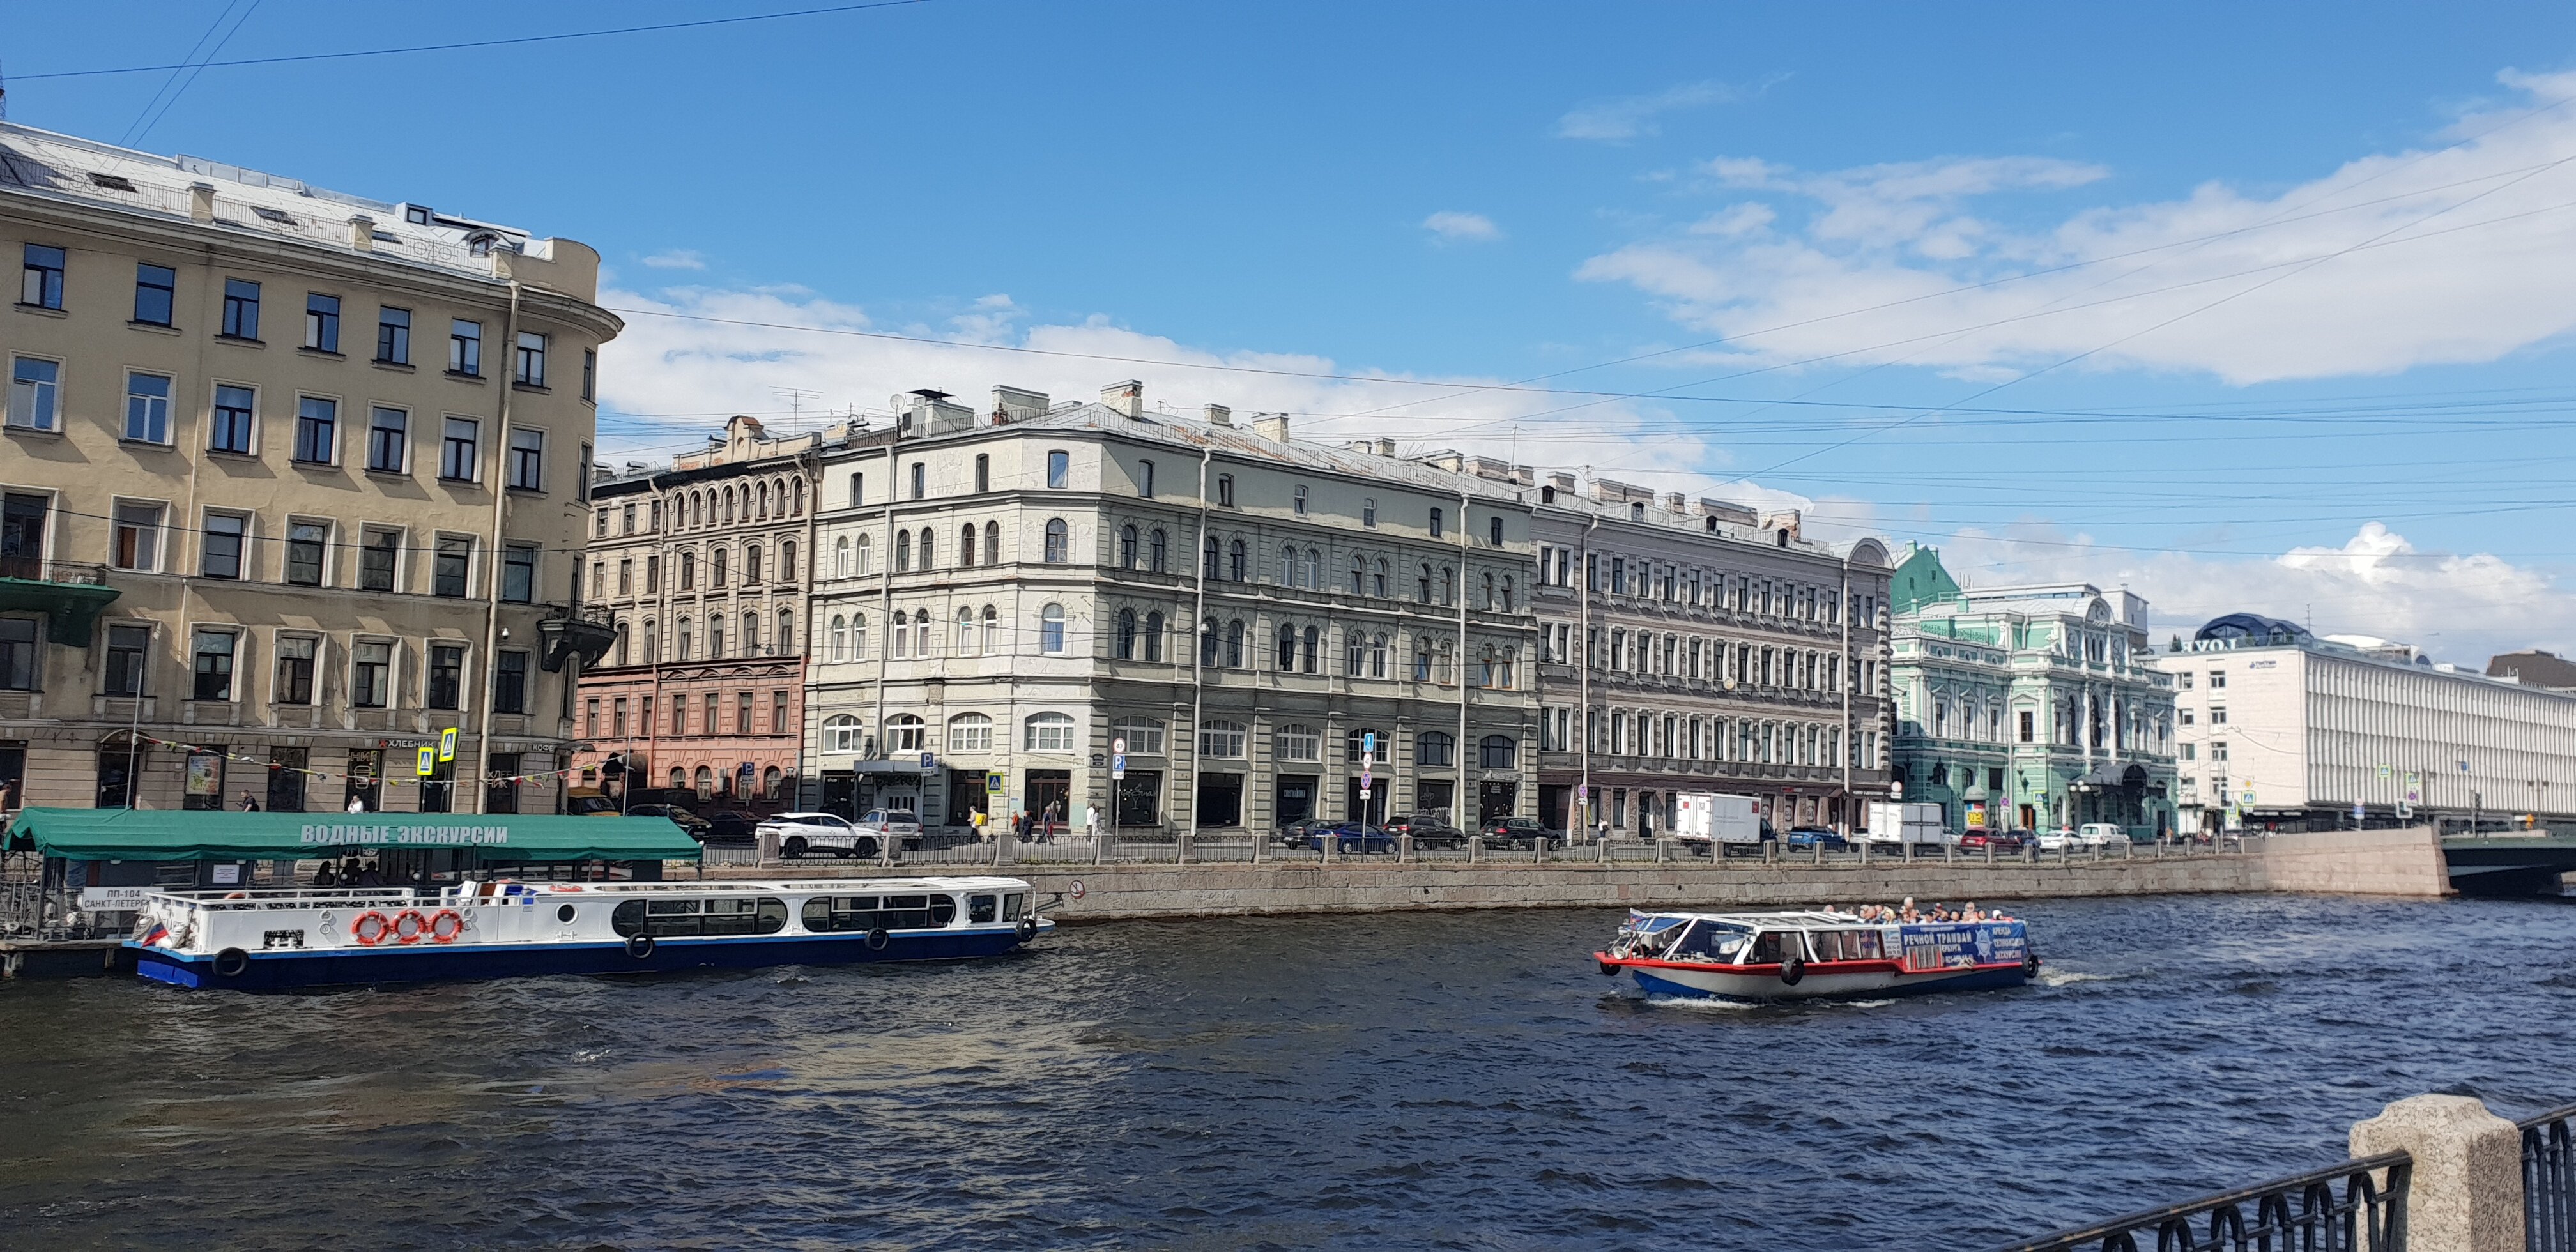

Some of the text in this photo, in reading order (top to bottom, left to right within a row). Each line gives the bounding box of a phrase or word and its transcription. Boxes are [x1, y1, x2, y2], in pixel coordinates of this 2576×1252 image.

[348, 751, 377, 762] НИК
[300, 825, 508, 845] ВОДНЫЕ ЭКСКУРСИИ
[107, 890, 141, 898] ПП-104
[1903, 932, 1935, 945] РЕЧНОЙ
[1936, 929, 1972, 944] ТРАМВАЙ
